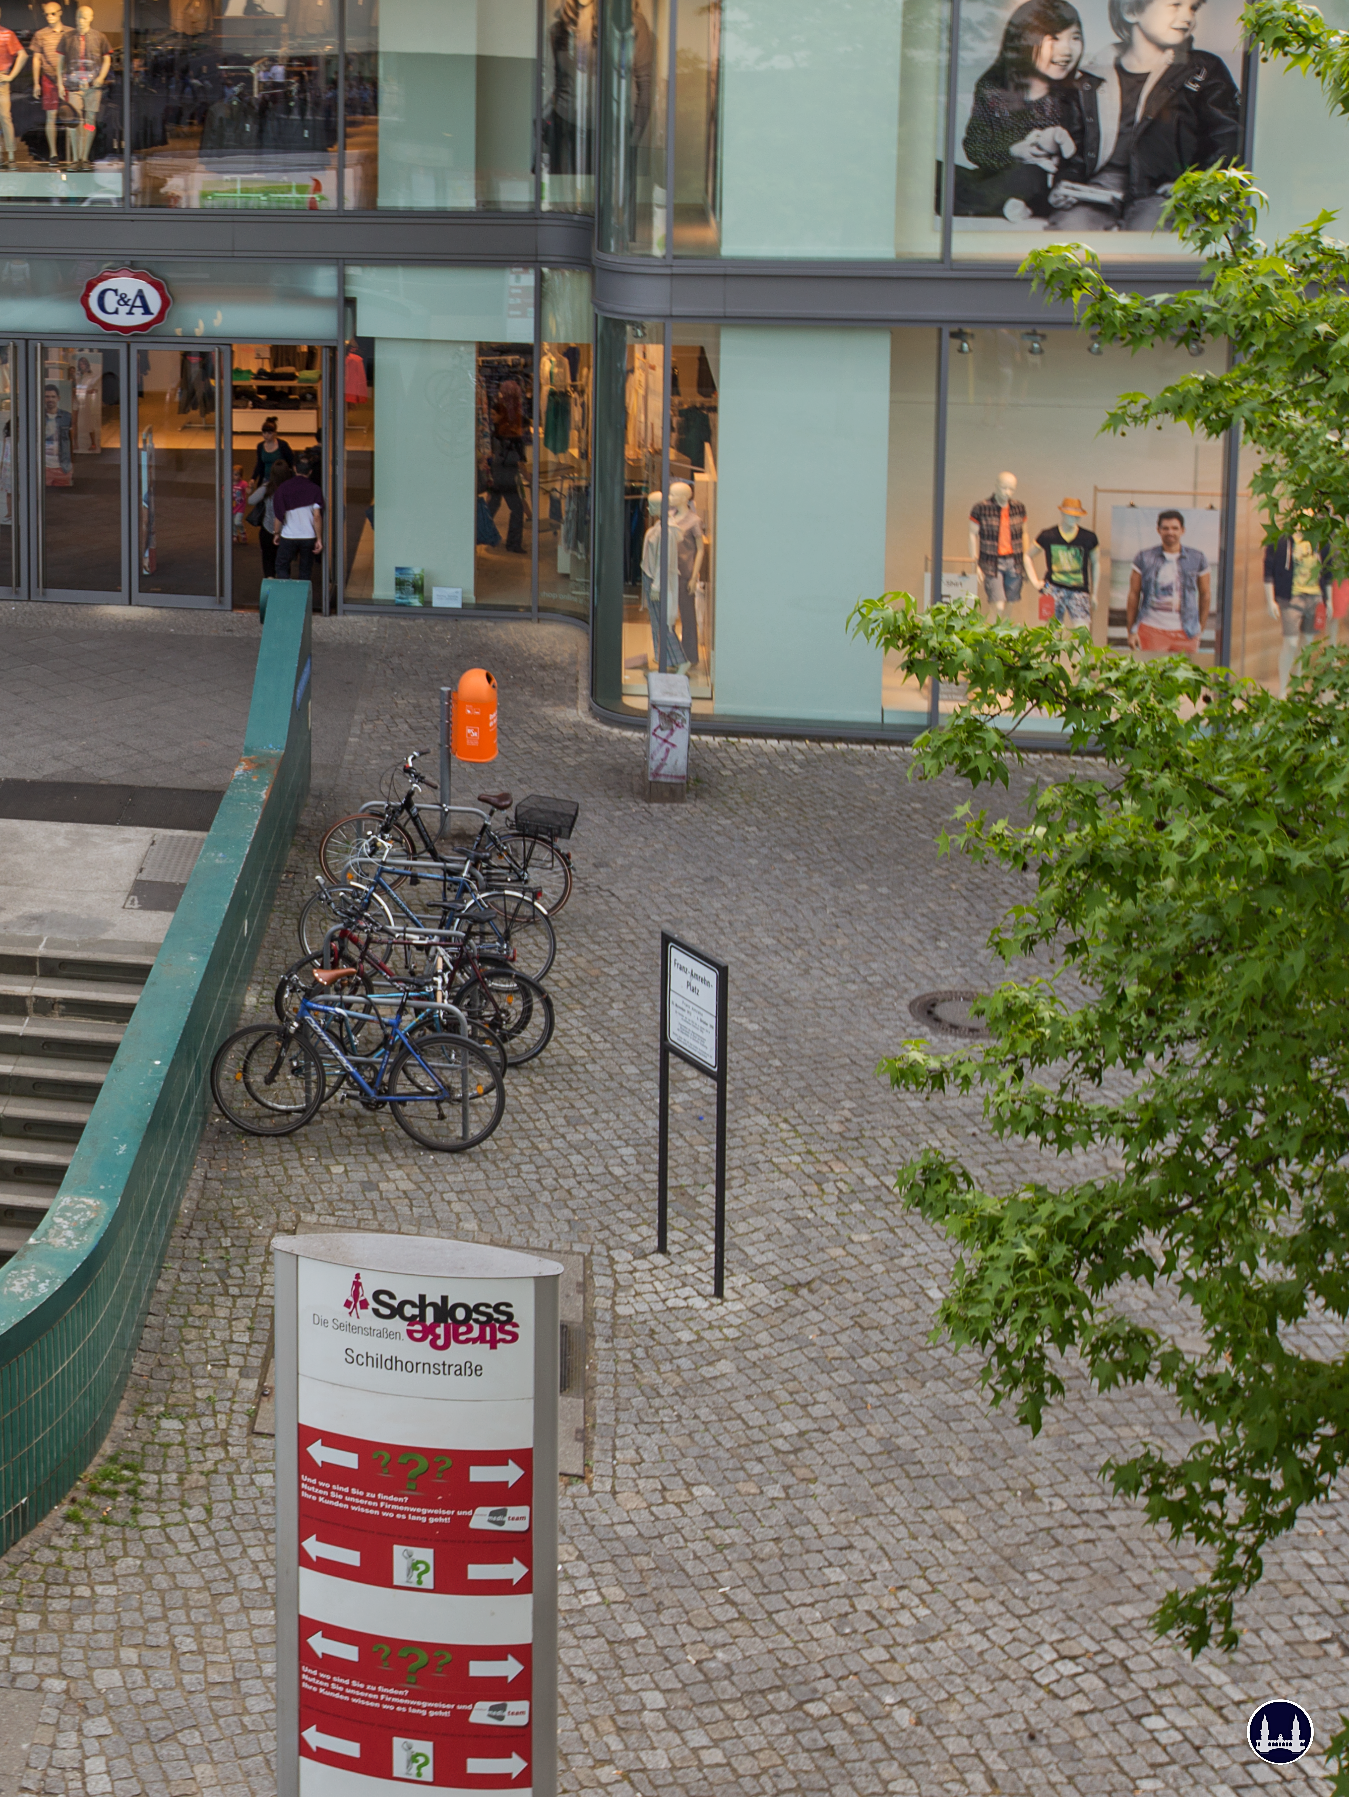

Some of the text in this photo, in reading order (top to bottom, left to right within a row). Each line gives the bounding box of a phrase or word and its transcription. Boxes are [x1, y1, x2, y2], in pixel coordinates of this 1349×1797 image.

[97, 287, 155, 316] C&A
[673, 958, 713, 988] Franz-Amrehn-
[686, 980, 700, 997] Platz
[371, 1289, 515, 1326] Schloss
[312, 1313, 404, 1341] Die Seitenstraßen.
[344, 1347, 484, 1378] Schildhornstraße
[301, 1474, 317, 1485] Und
[318, 1480, 330, 1489] wo
[332, 1484, 349, 1493] sind
[351, 1488, 364, 1497] Sie
[377, 1493, 409, 1503] finden?
[301, 1482, 329, 1496] Nutzen
[330, 1490, 343, 1500] Sie
[345, 1495, 378, 1507] unseren
[379, 1502, 455, 1516] Firmenwegweiser
[301, 1490, 317, 1502] Ihre
[318, 1496, 349, 1509] Kunden
[350, 1504, 380, 1516] wissen
[381, 1510, 394, 1518] wo
[408, 1514, 427, 1523] lang
[507, 1514, 527, 1522] team
[301, 1665, 318, 1676] Und
[319, 1672, 331, 1680] wo
[332, 1676, 350, 1685] sind
[351, 1680, 365, 1689] Sie
[377, 1685, 409, 1696] finden?
[301, 1673, 329, 1688] Nutzen
[330, 1682, 344, 1692] Sie
[345, 1687, 379, 1699] unseren
[380, 1694, 455, 1709] Firmenwegweiser
[301, 1681, 318, 1693] Ihre
[319, 1687, 350, 1701] Kunden
[351, 1697, 380, 1708] wissen
[382, 1703, 395, 1711] wo
[396, 1705, 407, 1713] es
[408, 1707, 427, 1716] lang
[506, 1709, 527, 1717] team
